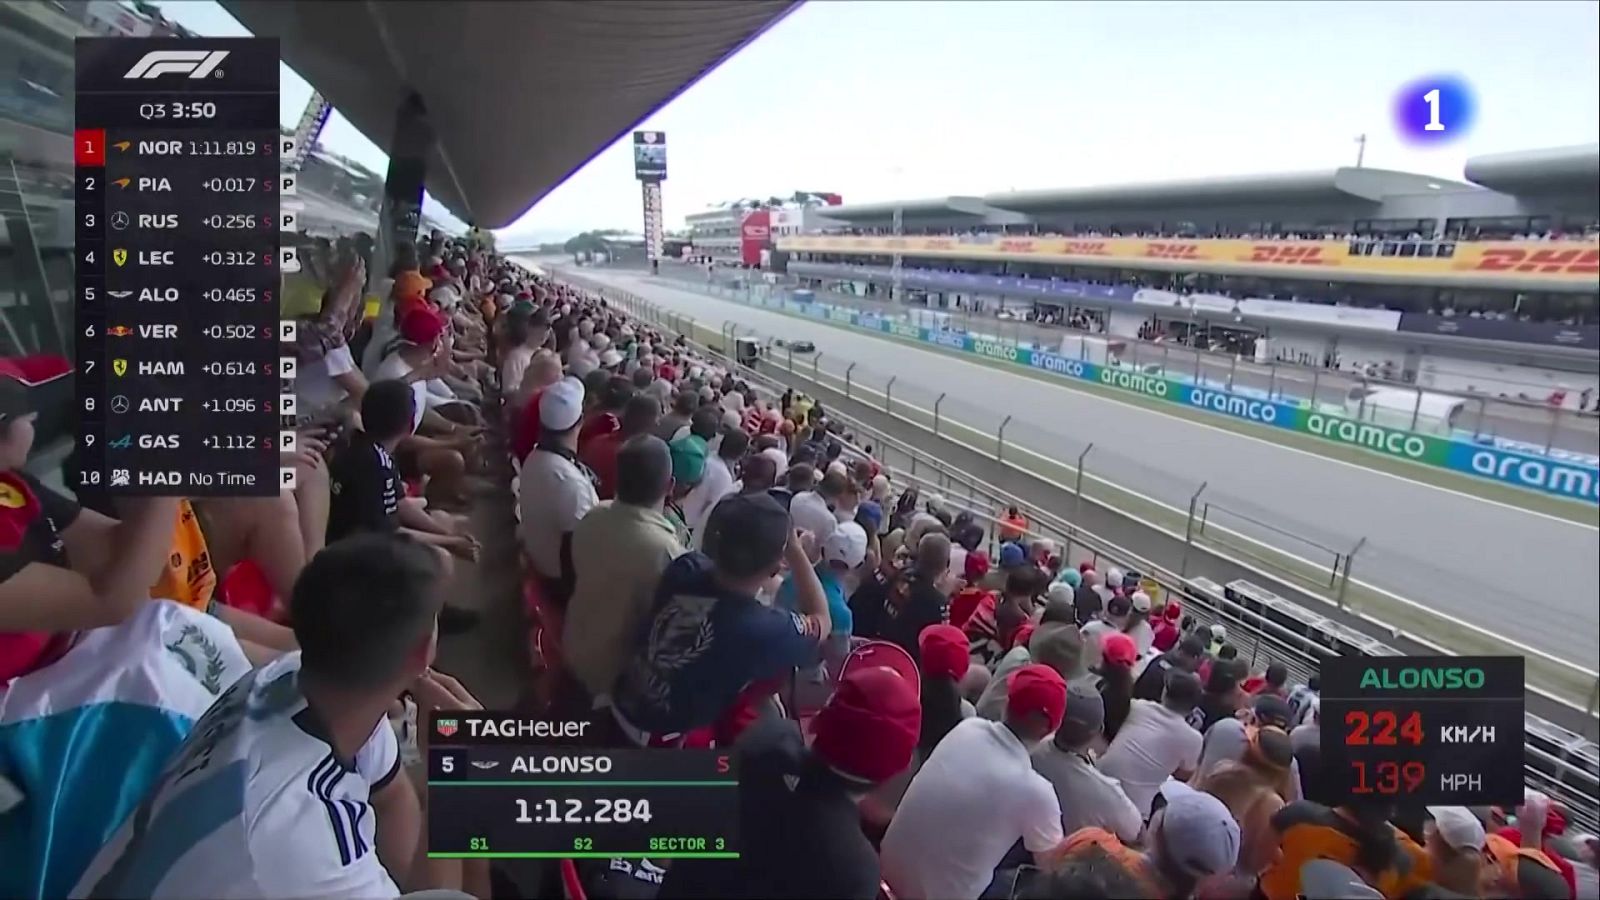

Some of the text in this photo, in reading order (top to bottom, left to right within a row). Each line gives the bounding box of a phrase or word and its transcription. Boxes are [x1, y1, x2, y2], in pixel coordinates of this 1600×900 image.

[1147, 244, 1198, 260] DHL
[1251, 246, 1323, 264] DHL
[1476, 249, 1599, 272] DHL
[974, 340, 1018, 360] aramco
[1030, 353, 1083, 377] aramco
[1101, 368, 1167, 396] aramco
[1190, 389, 1276, 421] aramco
[1307, 414, 1425, 457] aramco
[1471, 452, 1599, 497] aram
